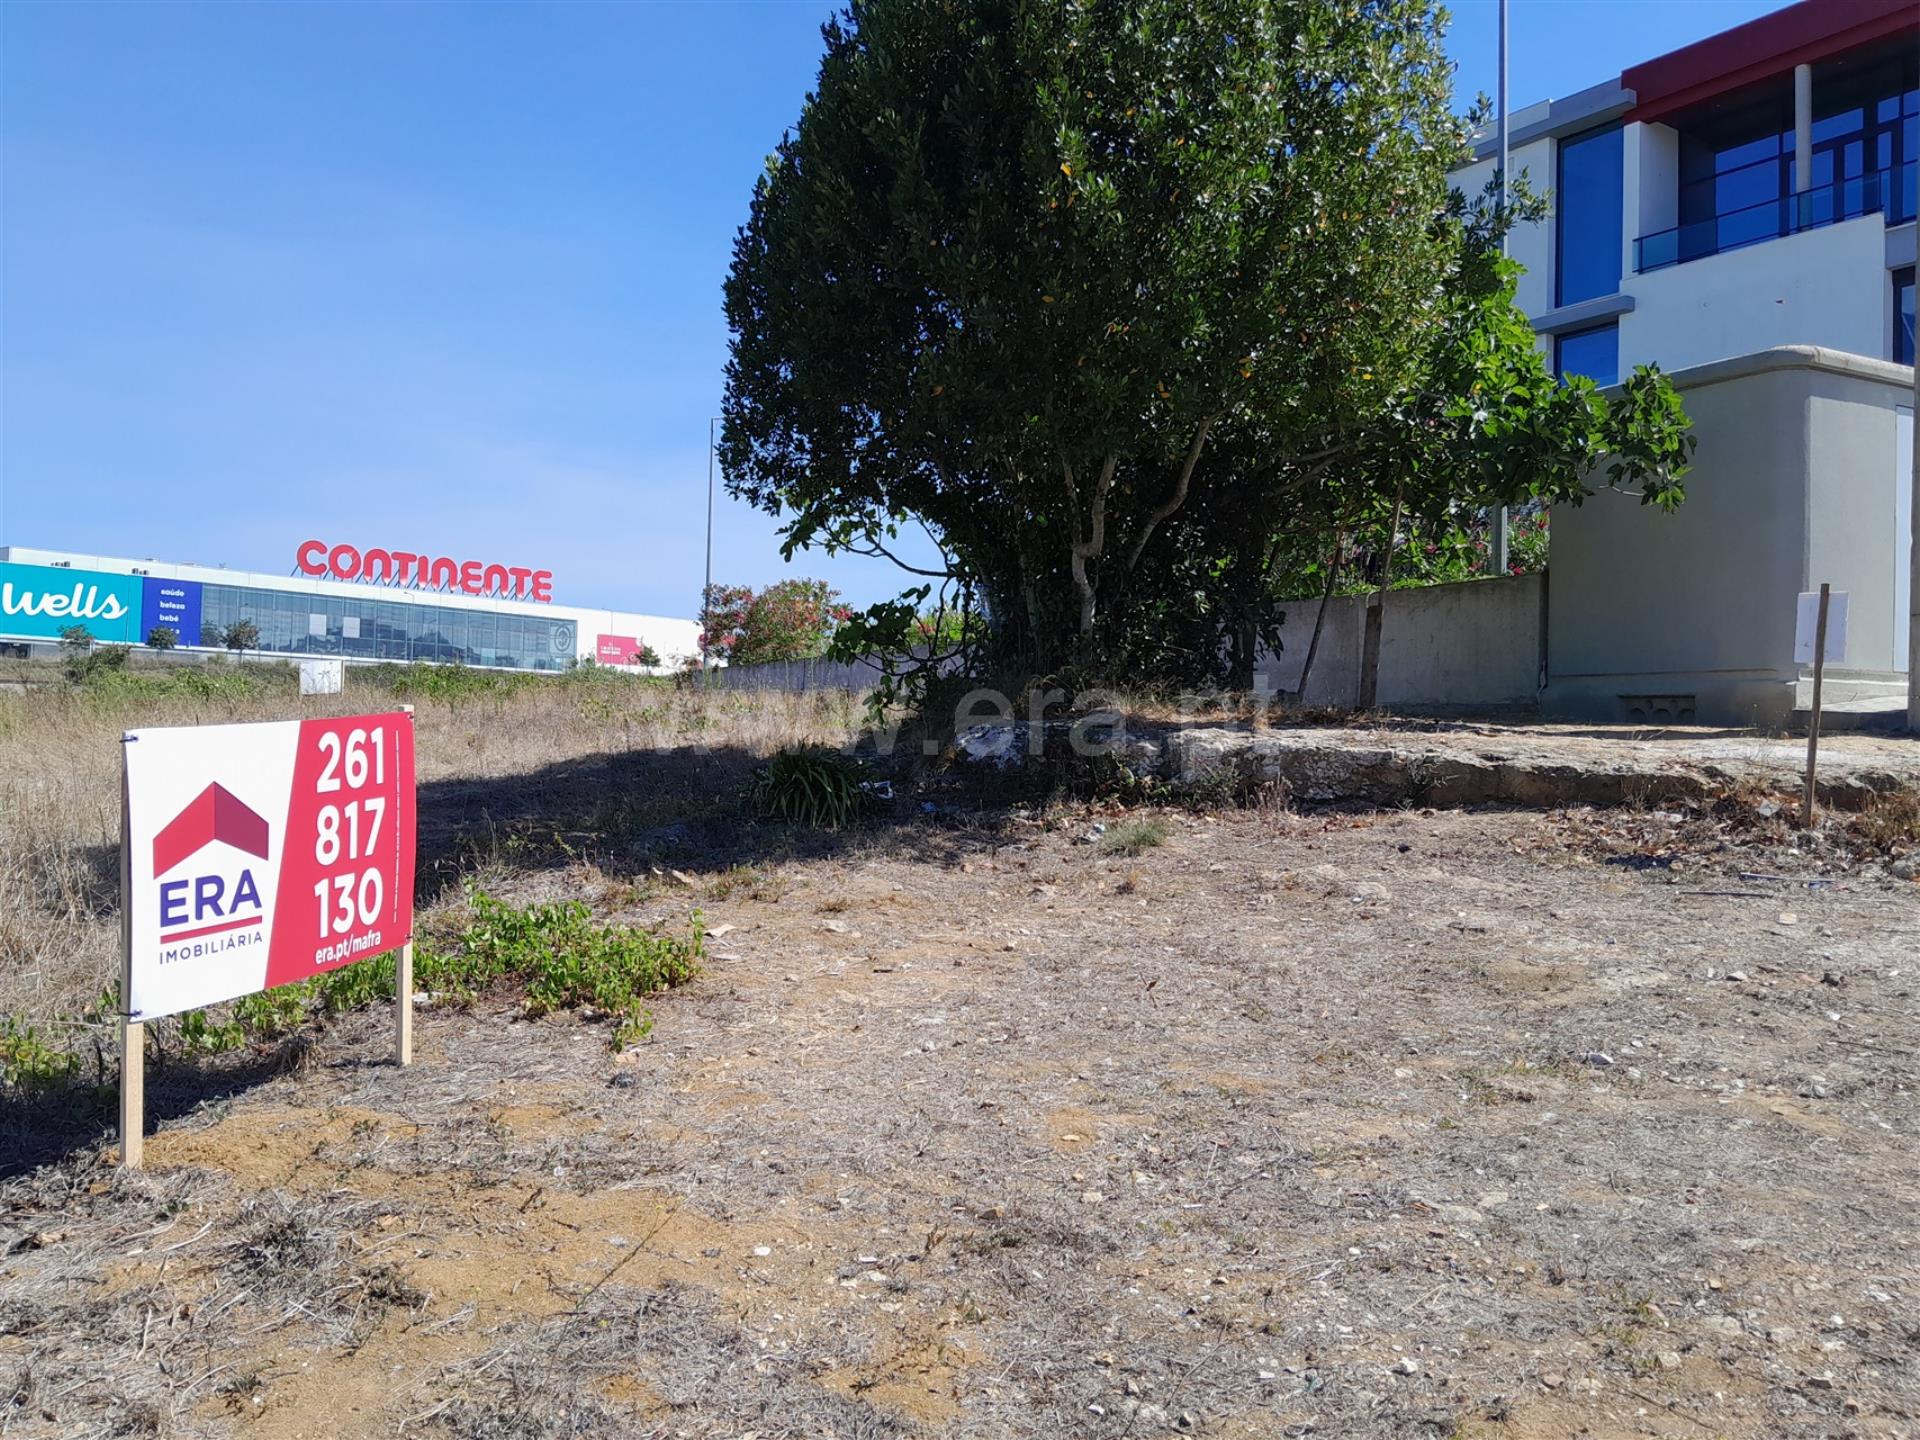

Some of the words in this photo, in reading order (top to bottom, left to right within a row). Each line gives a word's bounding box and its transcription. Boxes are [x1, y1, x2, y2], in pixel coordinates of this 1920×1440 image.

[296, 540, 552, 602] CONTINENTE
[159, 600, 186, 610] beleza
[316, 726, 385, 794] 261
[315, 797, 386, 866] 817
[160, 868, 262, 928] ERA
[314, 867, 384, 938] 130
[159, 930, 263, 965] IMOBILIÁRIA
[315, 929, 381, 966] era.pt/mafra
